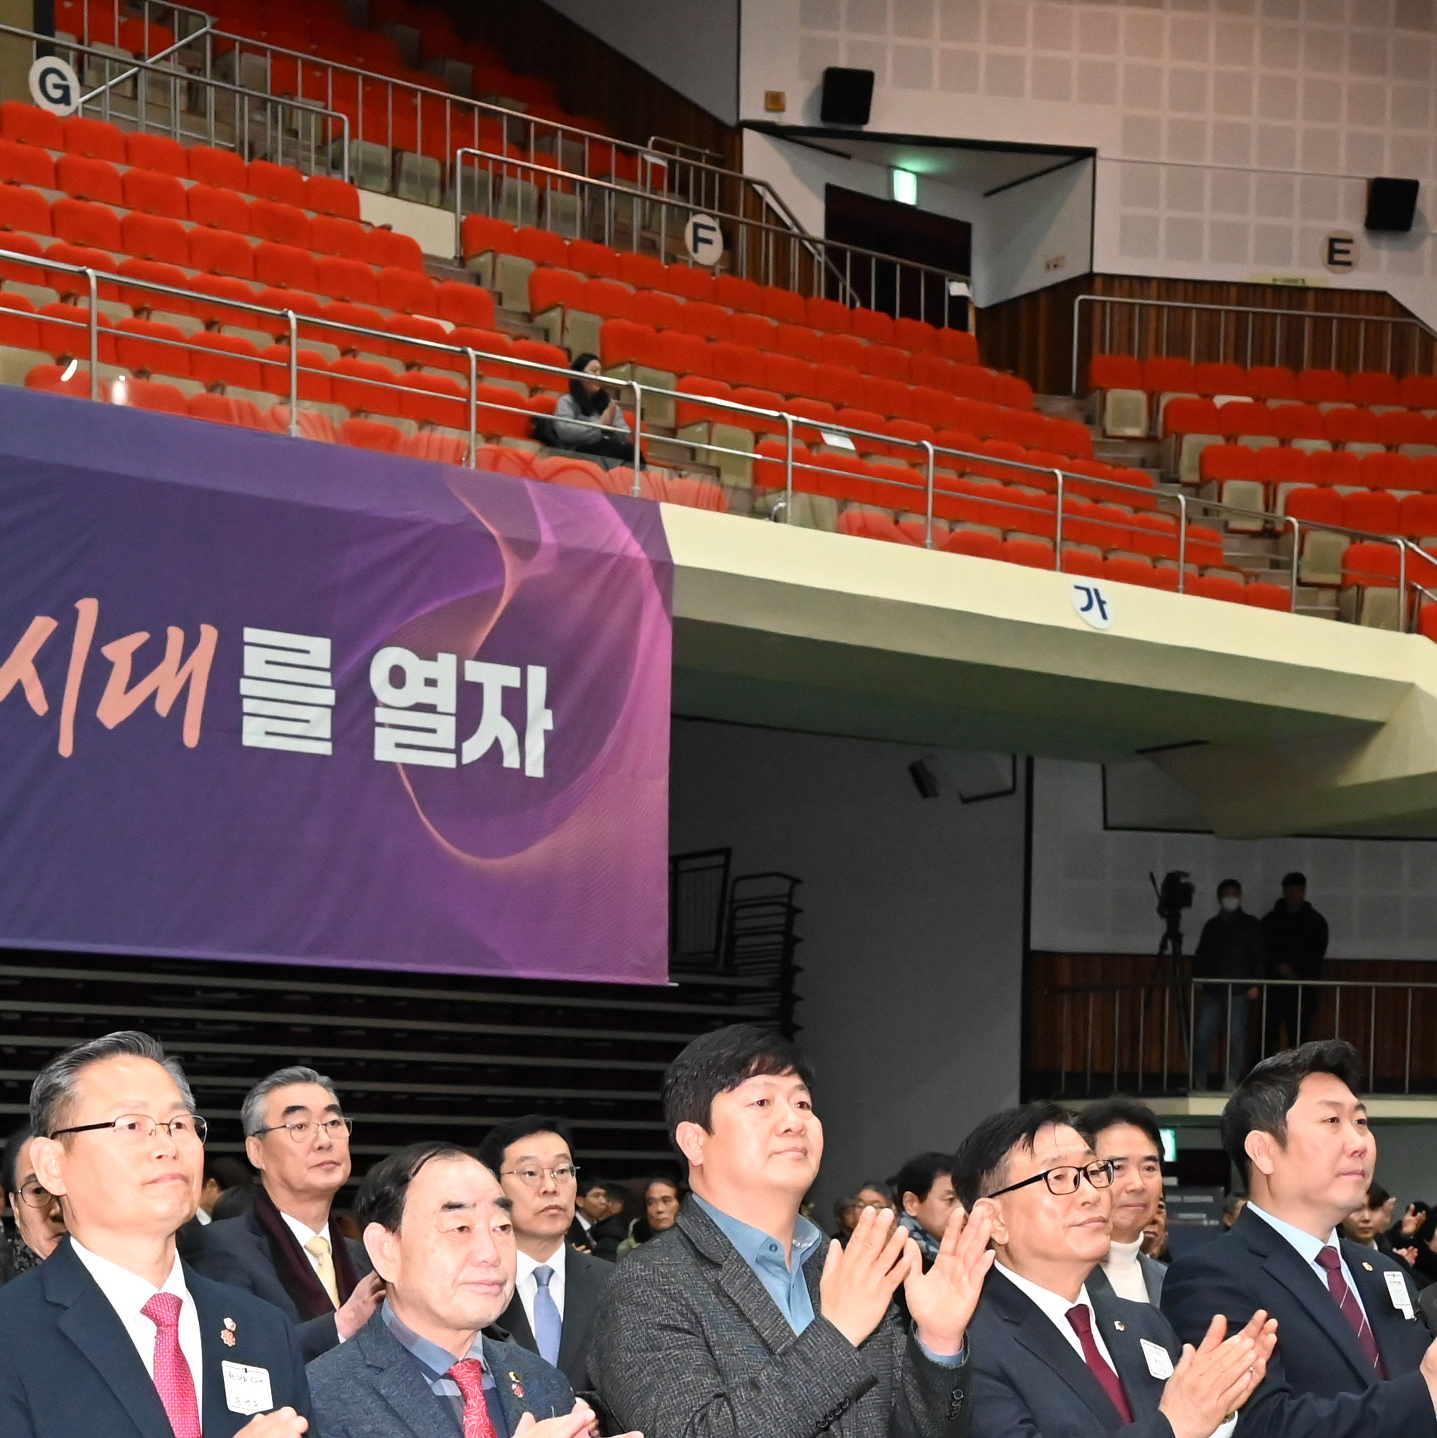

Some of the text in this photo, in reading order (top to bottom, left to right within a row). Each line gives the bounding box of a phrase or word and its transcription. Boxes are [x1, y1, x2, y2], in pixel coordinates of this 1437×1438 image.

[39, 67, 72, 107] G
[692, 222, 718, 254] F
[1328, 237, 1354, 266] E
[1073, 585, 1108, 621] 가
[370, 647, 553, 777] 열자
